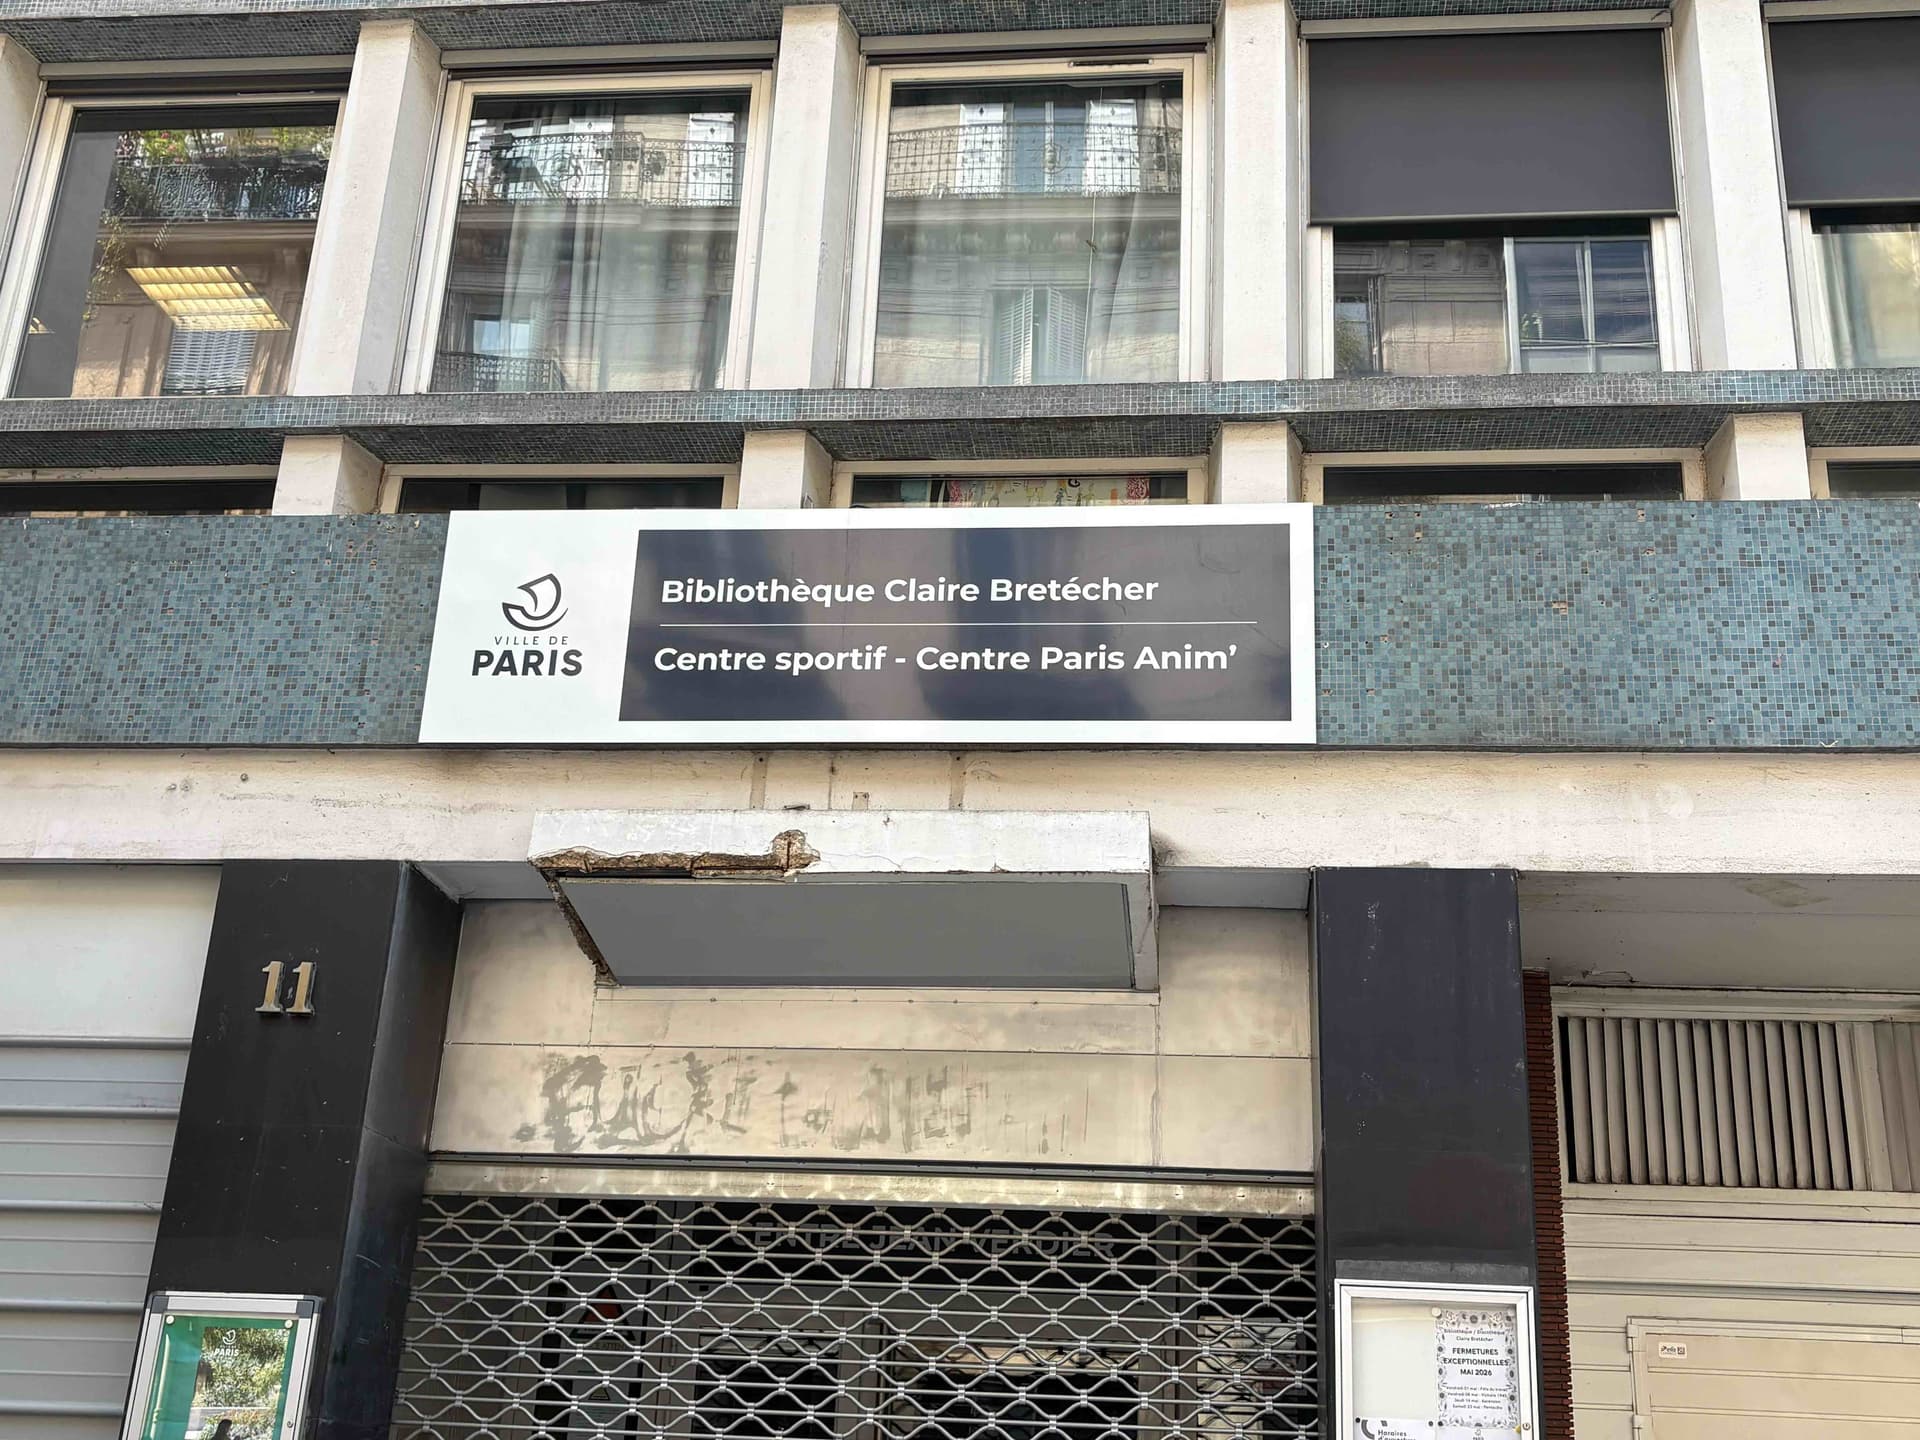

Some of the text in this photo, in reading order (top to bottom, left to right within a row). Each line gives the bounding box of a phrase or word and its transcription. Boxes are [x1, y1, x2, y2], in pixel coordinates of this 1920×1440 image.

[661, 576, 1159, 608] Bibliothèque Claire Bretécher
[494, 636, 569, 646] VILLE DE
[471, 649, 583, 677] PARIS
[654, 647, 766, 671] Centre
[775, 645, 888, 676] sportif
[916, 646, 1030, 671] Centre
[1041, 643, 1125, 670] Paris
[255, 960, 318, 1016] 11
[214, 1348, 240, 1357] PARIS
[1452, 1347, 1499, 1356] FERMETURES
[1443, 1357, 1509, 1367] EXCEPTIONNELLES
